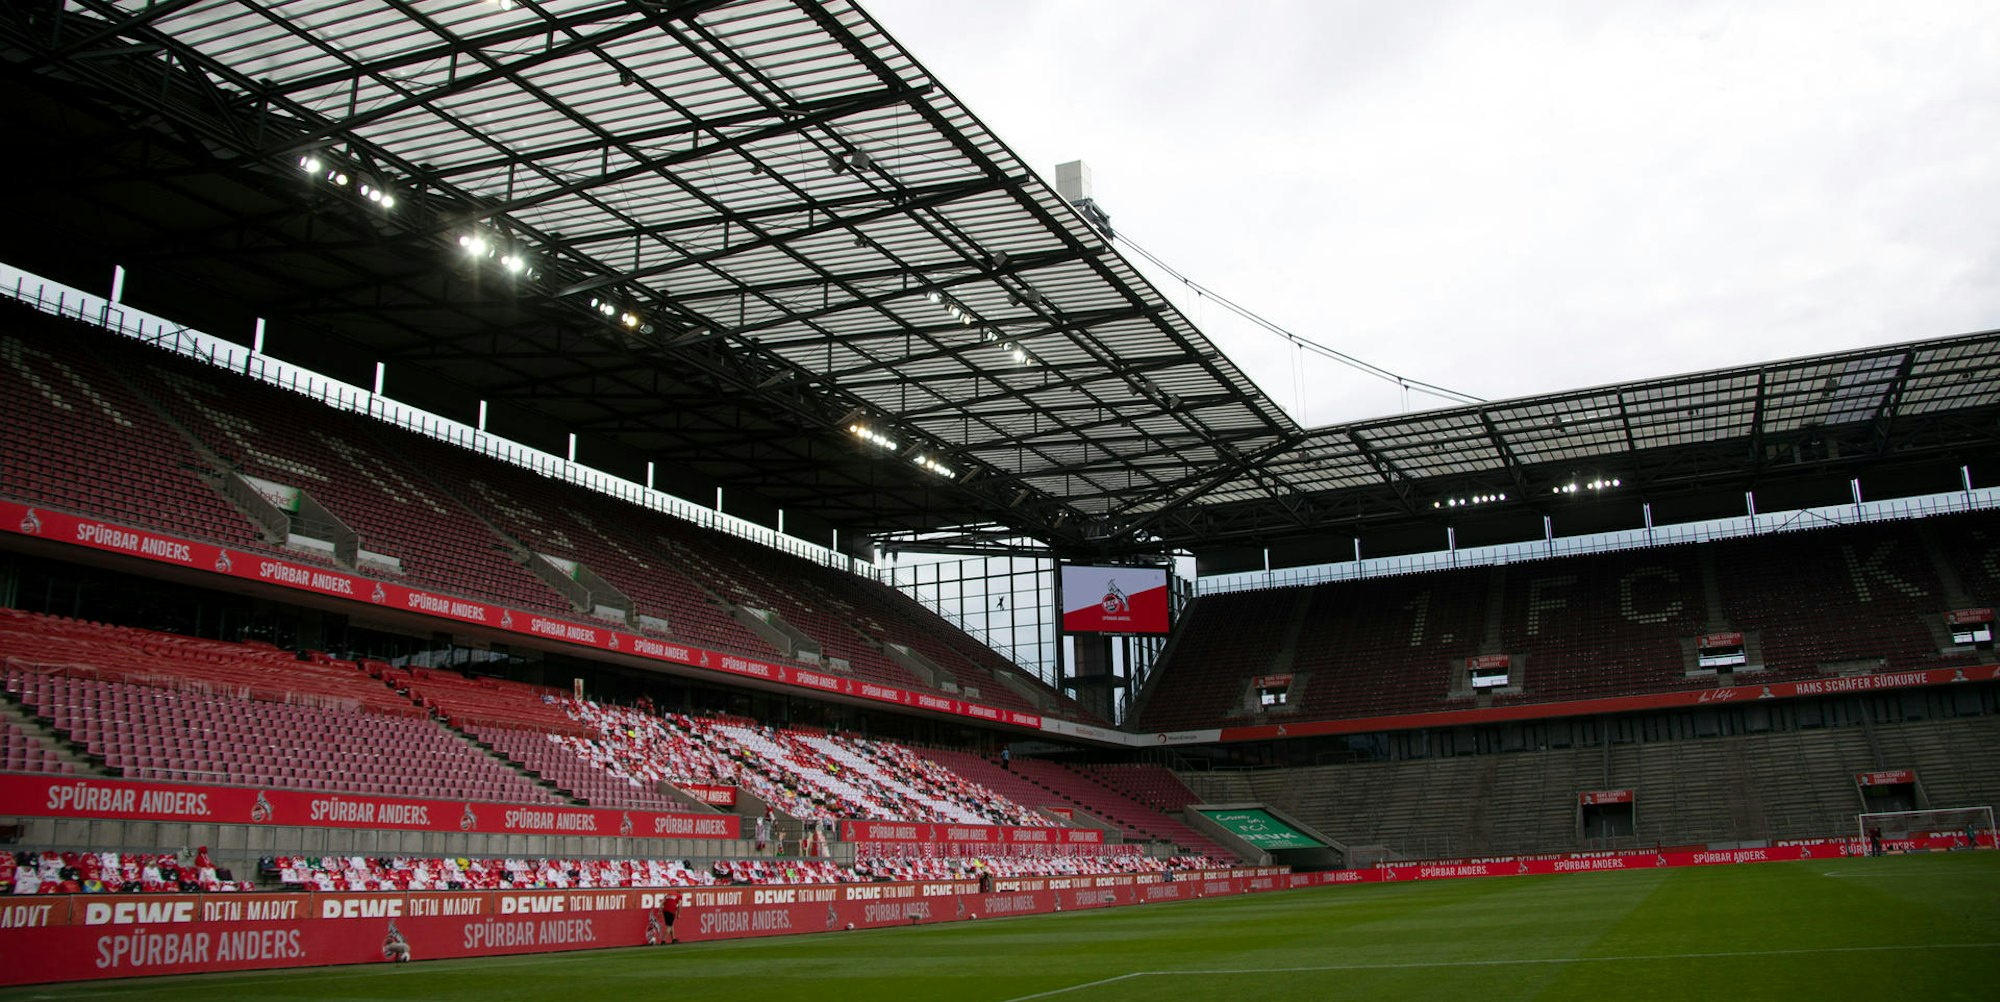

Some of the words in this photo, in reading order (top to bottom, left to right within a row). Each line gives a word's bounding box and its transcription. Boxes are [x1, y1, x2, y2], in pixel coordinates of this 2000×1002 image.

[77, 521, 140, 550] SPÜRBAR
[141, 536, 193, 562] ANDERS.
[260, 560, 309, 585] SPÜRBAR
[311, 570, 354, 594] ANDERS.
[408, 591, 449, 613] SPÜRBAR
[451, 601, 486, 621] ANDERS.
[531, 619, 566, 636] SPÜRBAR
[567, 626, 596, 643] ANDERS.
[634, 639, 663, 656] SPÜRBAR
[663, 646, 689, 662] ANDERS.
[722, 657, 747, 672] SPÜRBAR
[748, 663, 770, 676] ANDERS.
[1796, 682, 1822, 696] HANS
[1826, 678, 1872, 692] SCHÄFER
[1874, 672, 1928, 688] SÜDKURVE
[47, 782, 135, 812] SPÜRBAR
[140, 791, 211, 815] ANDERS.
[708, 790, 732, 802] ANDERS.
[311, 797, 374, 822] SPÜRBAR
[378, 804, 430, 825] ANDERS.
[505, 808, 554, 829] SPÜRBAR
[556, 813, 597, 831] ANDERS.
[655, 815, 693, 834] SPÜRBAR
[696, 819, 728, 834] ANDERS.
[869, 823, 894, 838] SPÜRBAR
[896, 826, 917, 839] ANDERS.
[1554, 860, 1590, 870] SPÜRBAR
[1592, 859, 1625, 868] ANDERS.
[1693, 852, 1731, 864] SPÜRBAR
[1734, 851, 1768, 862] ANDERS.
[1421, 867, 1455, 877] SPÜRBAR
[1458, 866, 1488, 876] ANDERS.
[641, 893, 692, 909] REE
[754, 890, 795, 904] REWE
[847, 887, 880, 900] REWE
[86, 902, 194, 924] REWE
[205, 902, 241, 921] DEIN
[323, 899, 402, 918] REWE
[410, 899, 438, 916] DEIN
[502, 896, 564, 913] REWE
[570, 896, 592, 911] DEIN
[865, 901, 900, 922] SPÜRBAR
[701, 909, 749, 933] SPÜRBAR
[752, 910, 792, 930] ANDERS.
[464, 918, 534, 948] SPÜRBAR
[539, 919, 596, 944] ANDERS.
[96, 928, 209, 968] SPÜRBAR
[217, 929, 305, 961] ANDERS.
